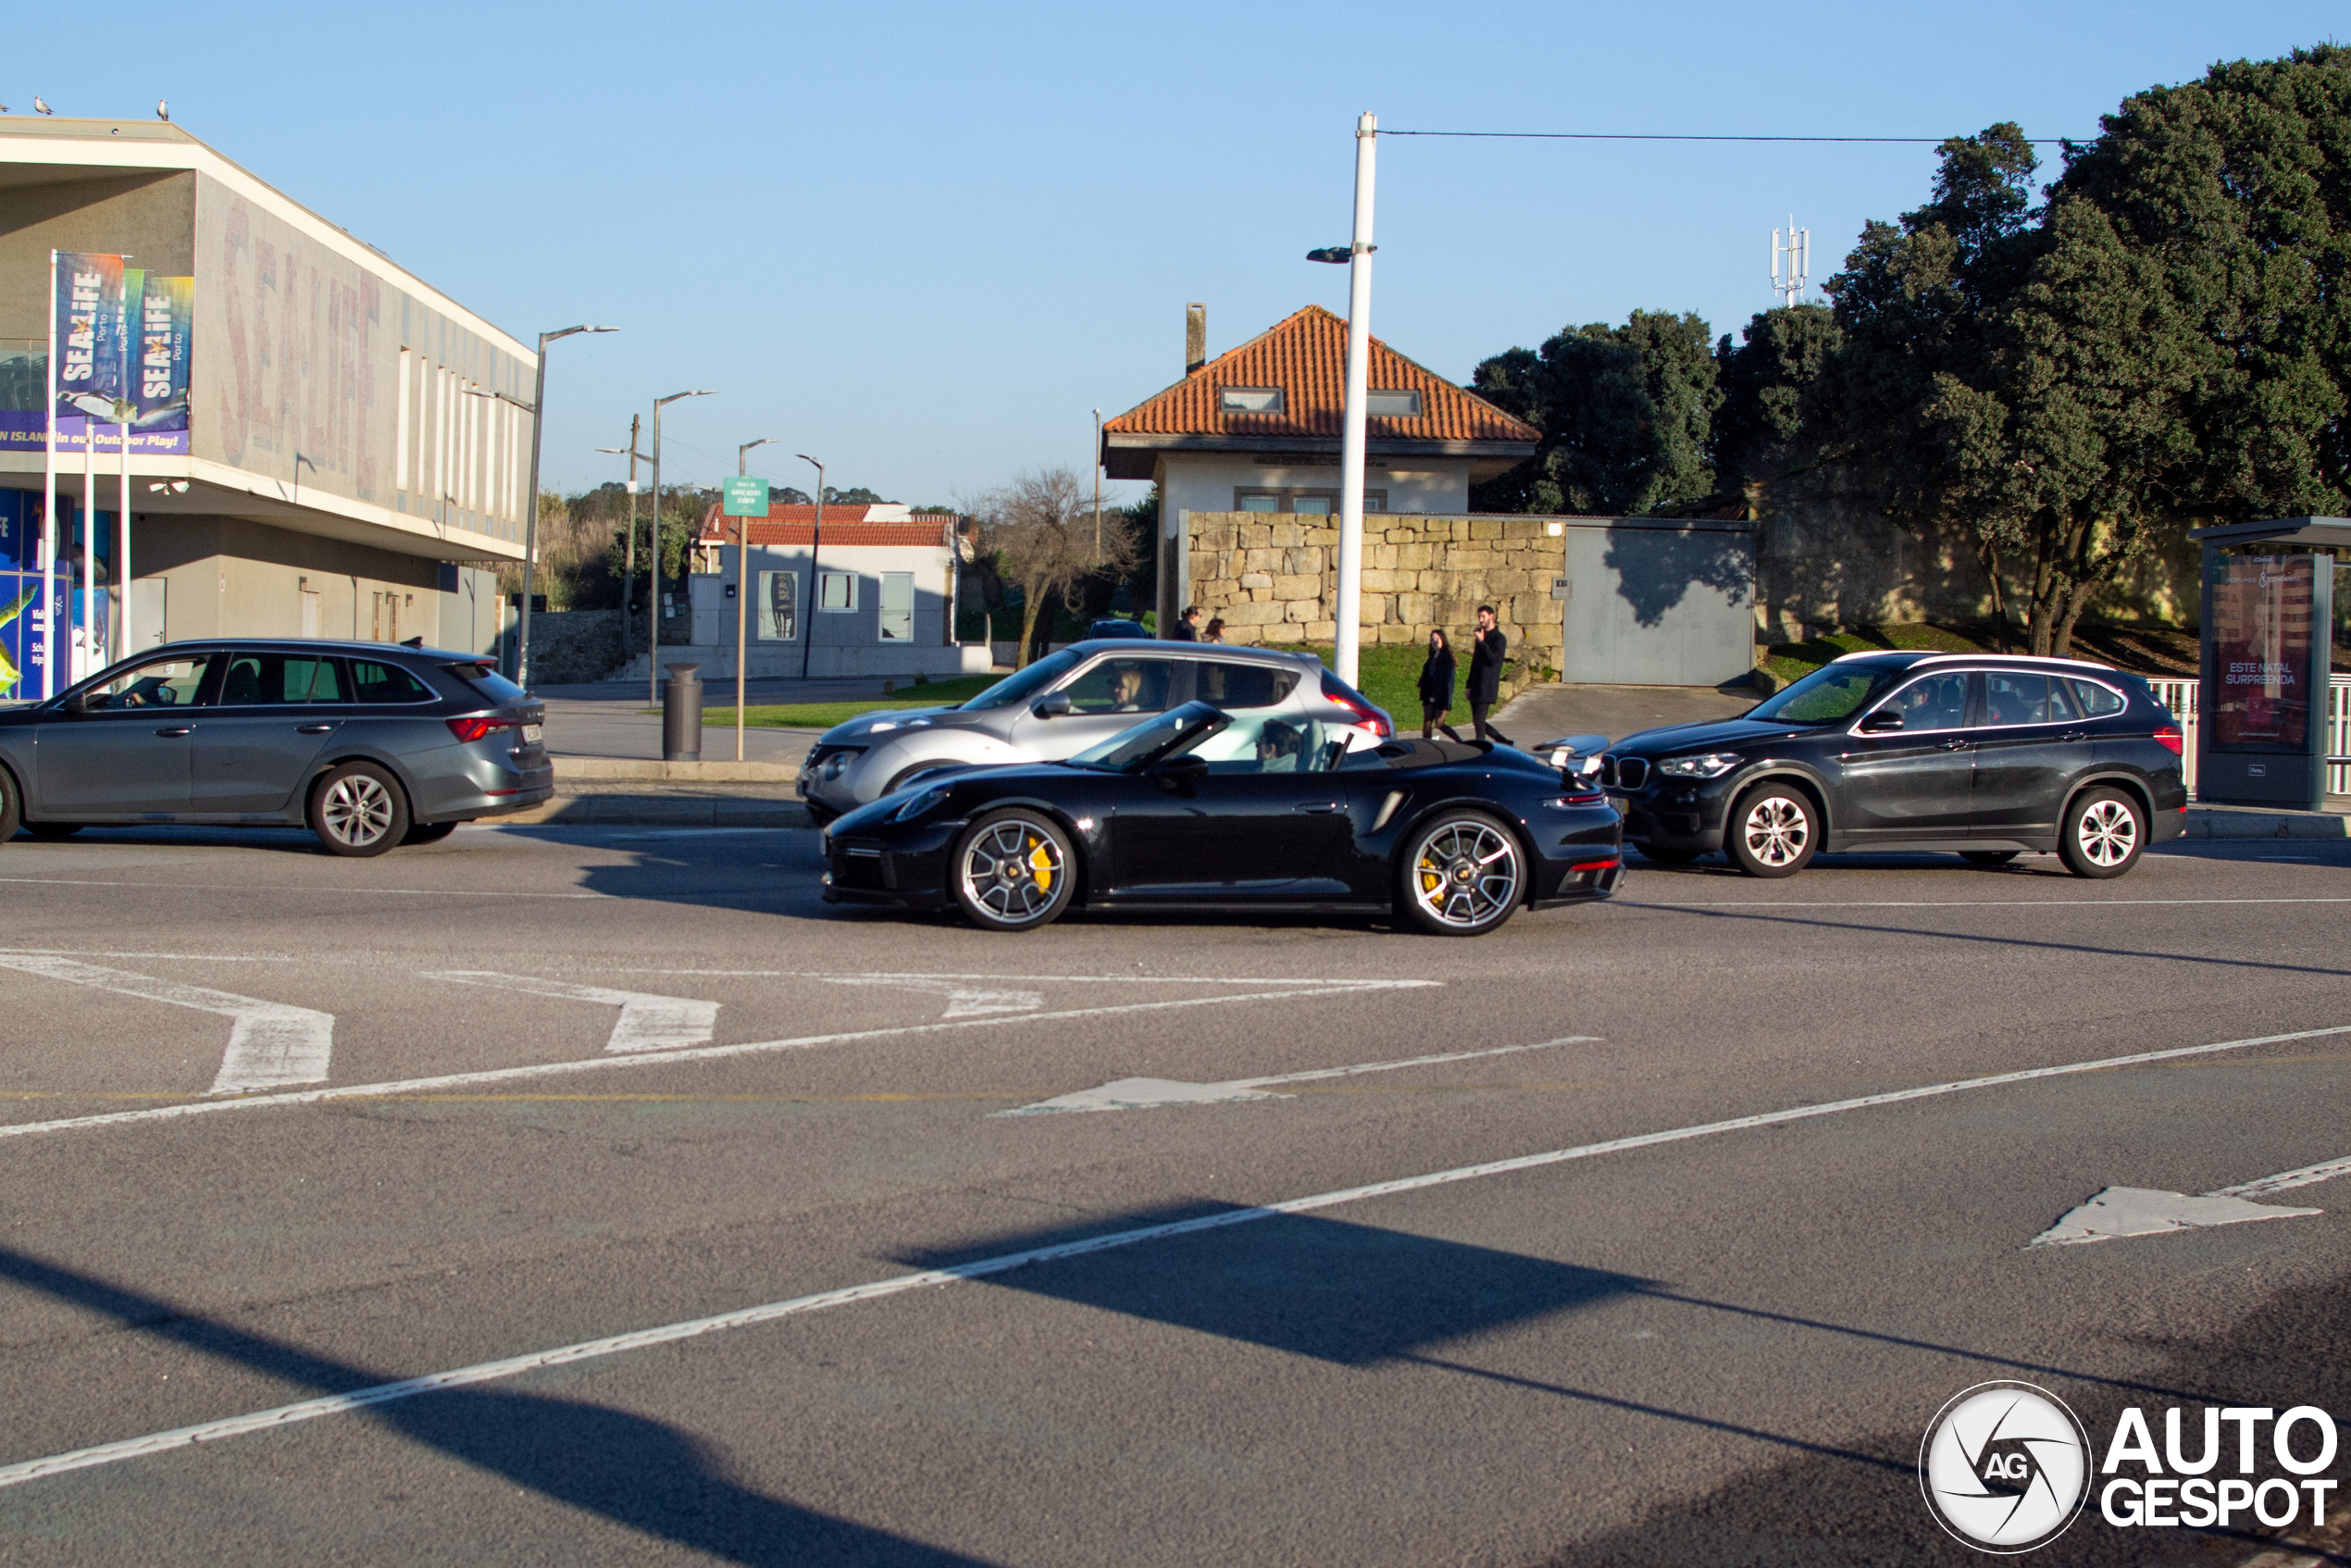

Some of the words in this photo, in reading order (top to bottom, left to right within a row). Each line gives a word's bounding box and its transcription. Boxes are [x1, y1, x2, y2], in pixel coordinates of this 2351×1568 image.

[97, 314, 108, 342] Porto
[118, 325, 129, 352] Porto
[63, 330, 95, 381] SEA
[173, 333, 182, 361] Porto
[143, 349, 171, 399] SEA
[11, 431, 48, 443] ISLAN
[56, 433, 68, 444] in
[146, 436, 180, 451] Play!
[2225, 674, 2295, 685] SURPREENDA
[2230, 663, 2257, 673] ESTE
[2258, 663, 2292, 673] NATAL
